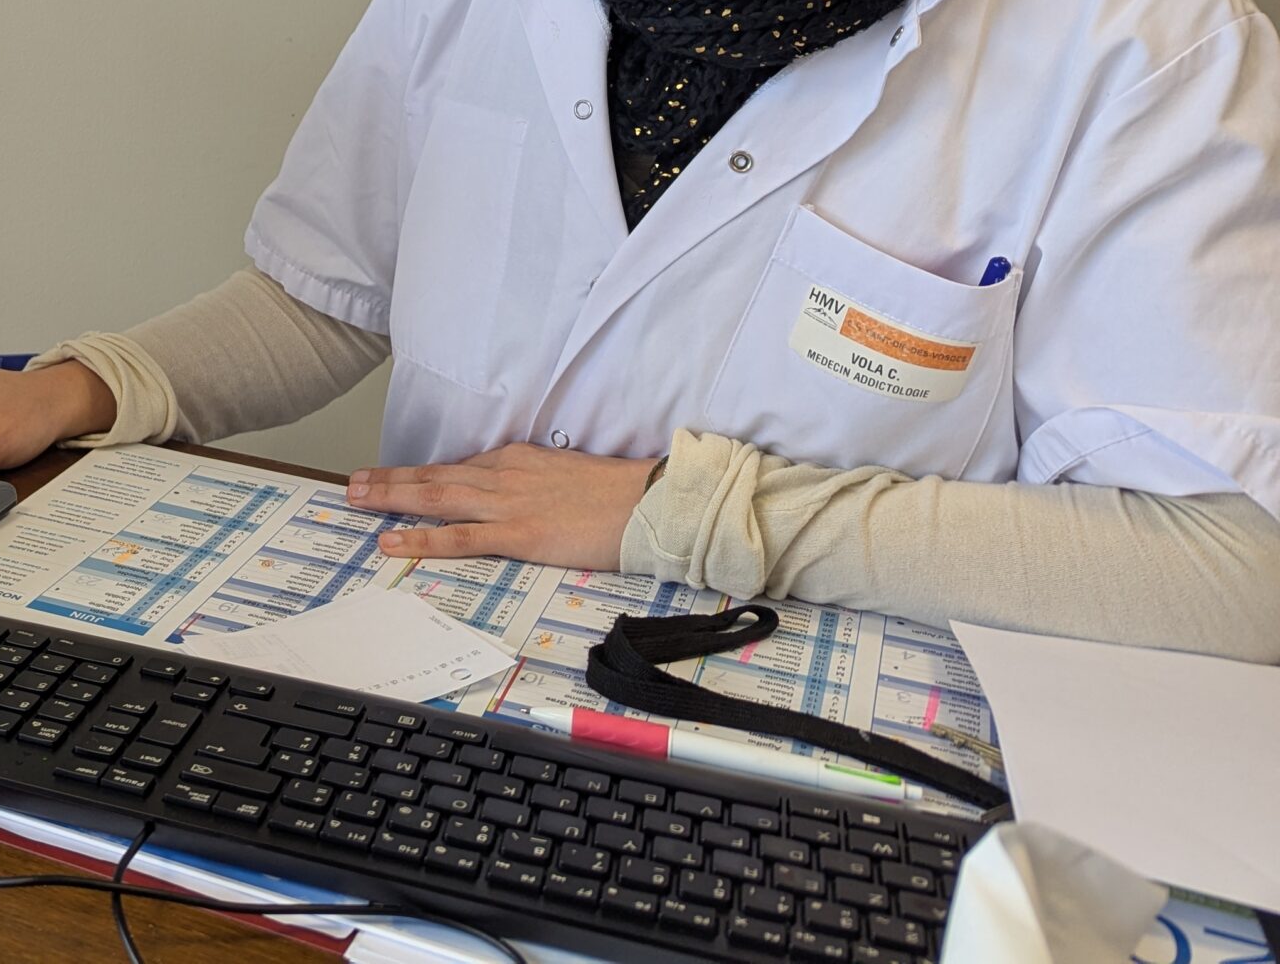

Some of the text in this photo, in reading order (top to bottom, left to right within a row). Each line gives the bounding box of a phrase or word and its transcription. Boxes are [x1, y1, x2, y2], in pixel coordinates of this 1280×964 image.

[808, 287, 846, 315] HMV
[850, 352, 901, 382] VOLA C.
[806, 349, 931, 399] MEDECIN ADDICTOLOGIE
[214, 601, 244, 614] 19
[69, 610, 106, 624] JUIN
[52, 663, 65, 671] 2
[35, 681, 49, 689] 5
[79, 691, 93, 699] 4
[564, 694, 600, 706] Carême
[17, 700, 31, 708] 8
[545, 697, 566, 706] Gras
[63, 710, 77, 719] 7
[95, 744, 114, 753] Fin
[72, 764, 99, 777] Inser
[110, 773, 146, 788] Pause
[500, 784, 518, 796] K
[610, 809, 628, 821] H
[292, 817, 315, 829] F12
